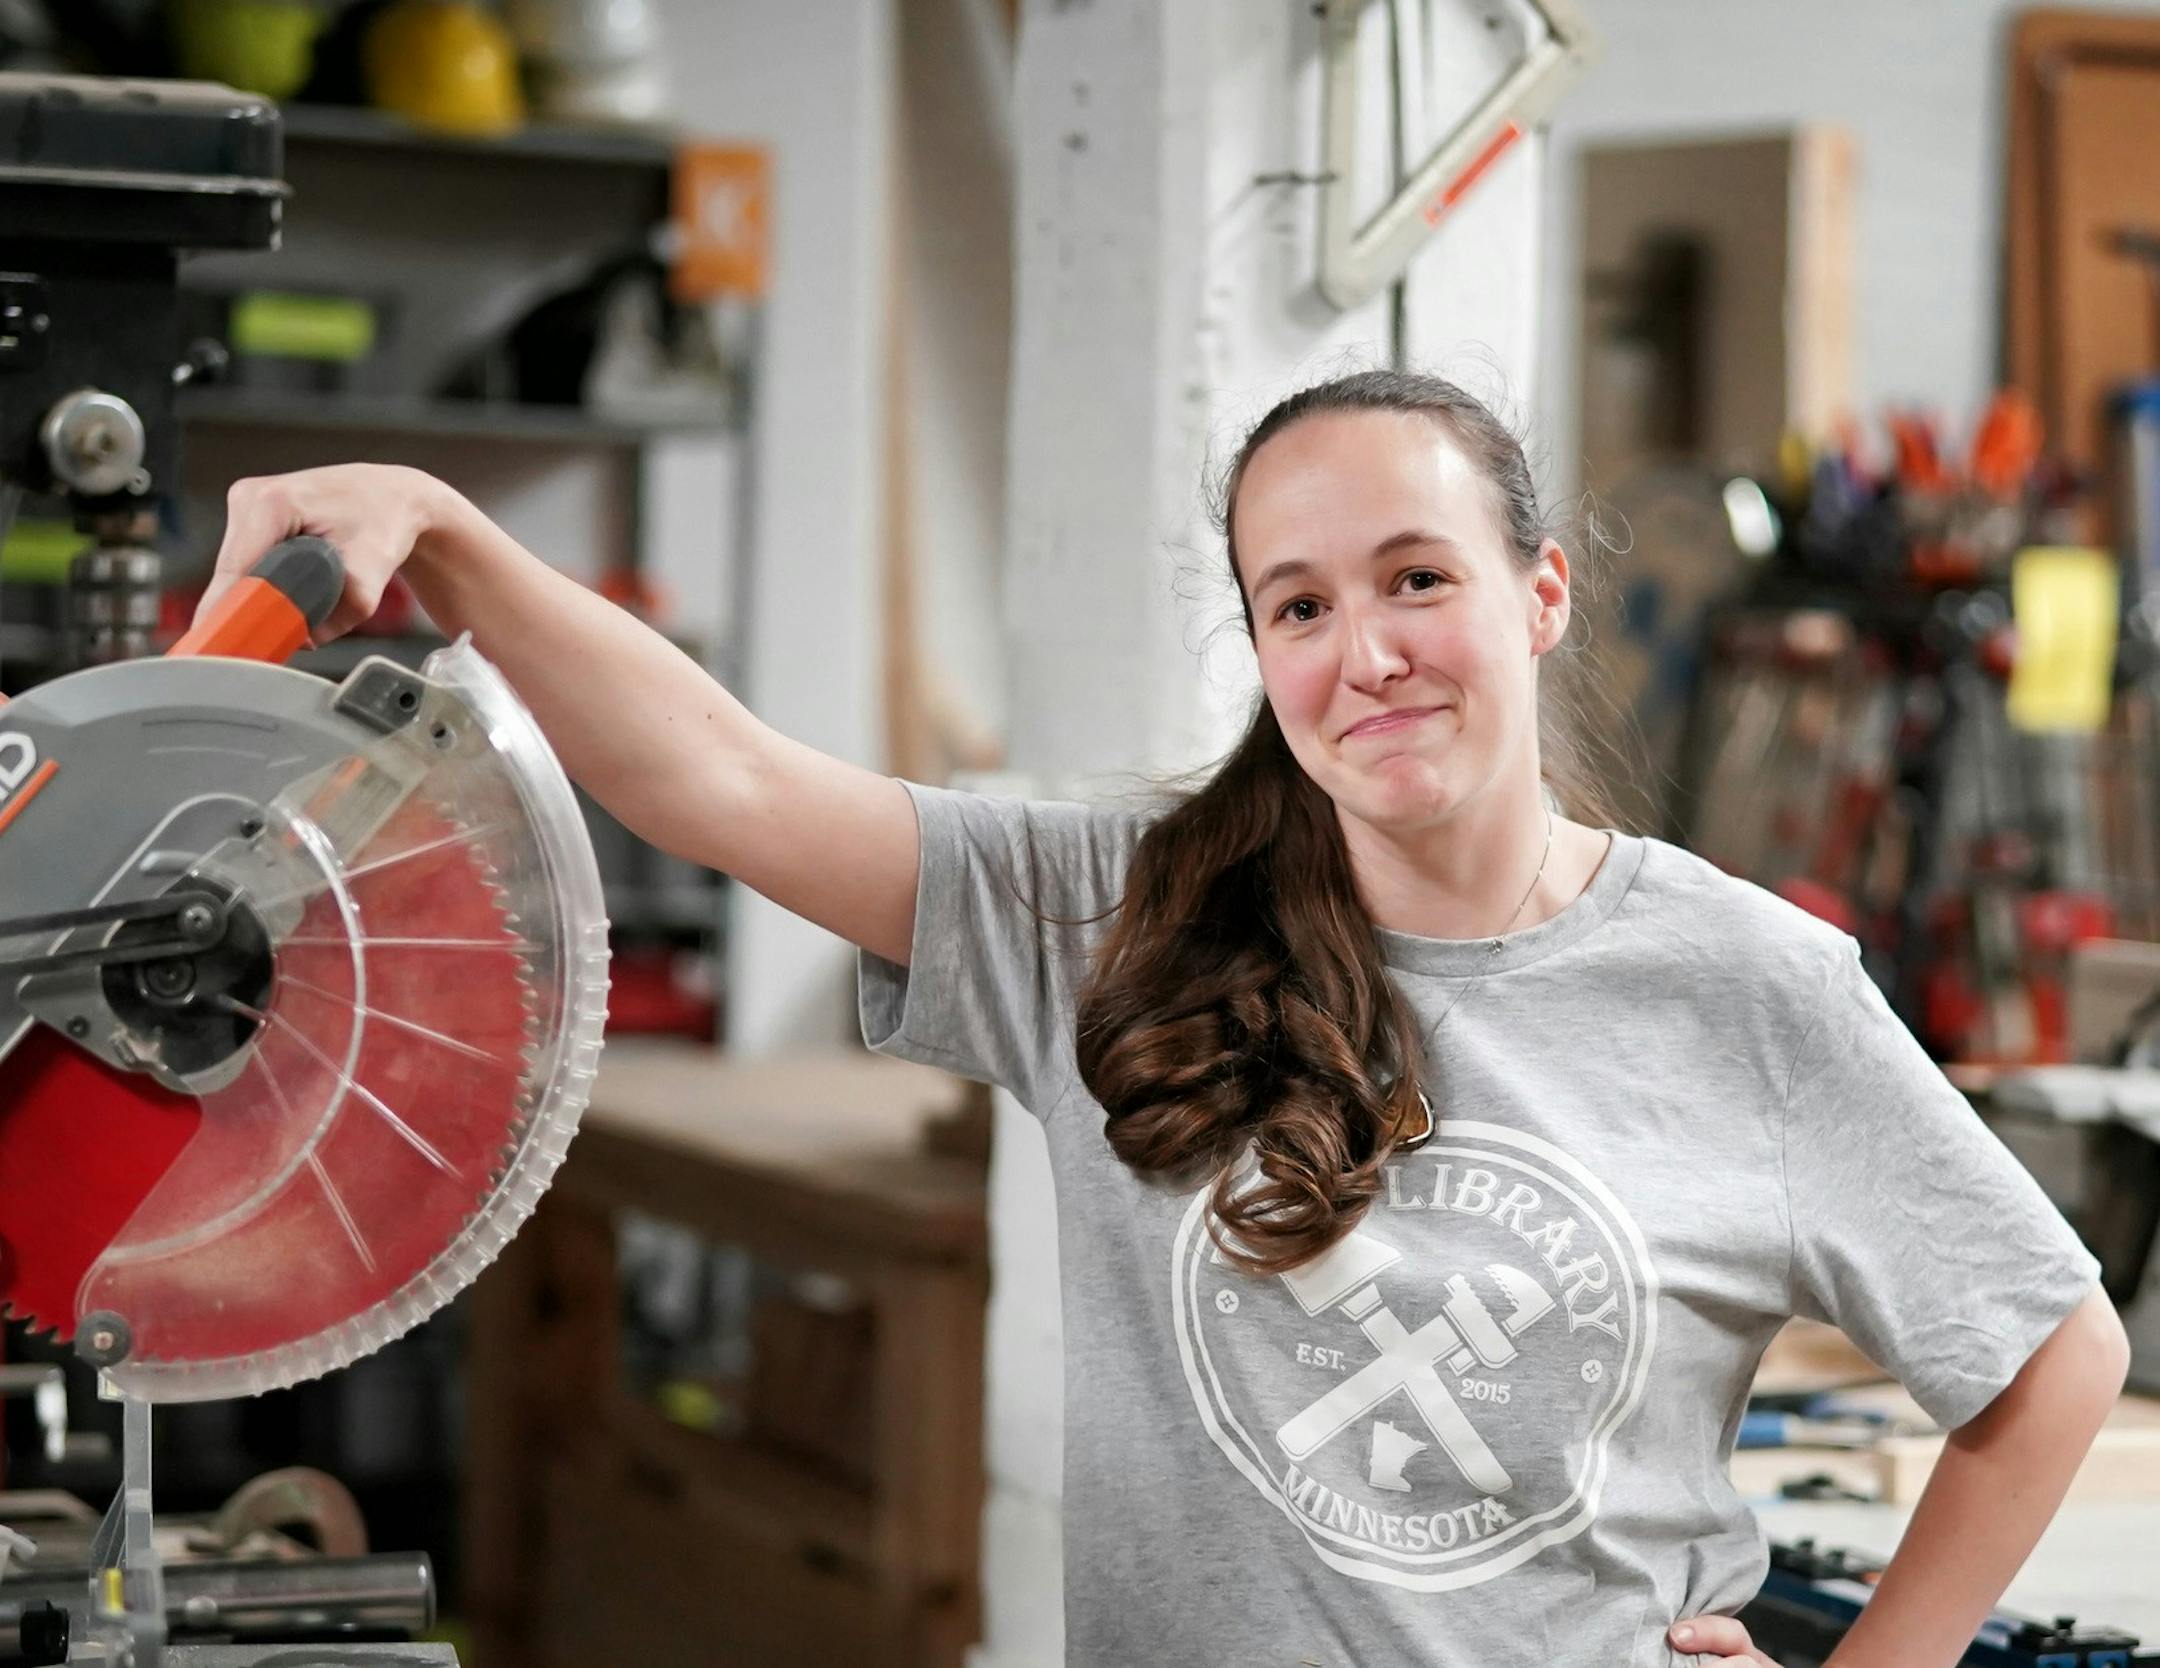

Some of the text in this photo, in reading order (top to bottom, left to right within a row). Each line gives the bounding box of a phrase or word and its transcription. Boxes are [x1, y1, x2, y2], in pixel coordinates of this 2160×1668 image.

[1386, 1163, 1625, 1343] LIBRARY
[1296, 1343, 1512, 1405] EST. 2015
[1282, 1462, 1517, 1552] MINNESOTA
